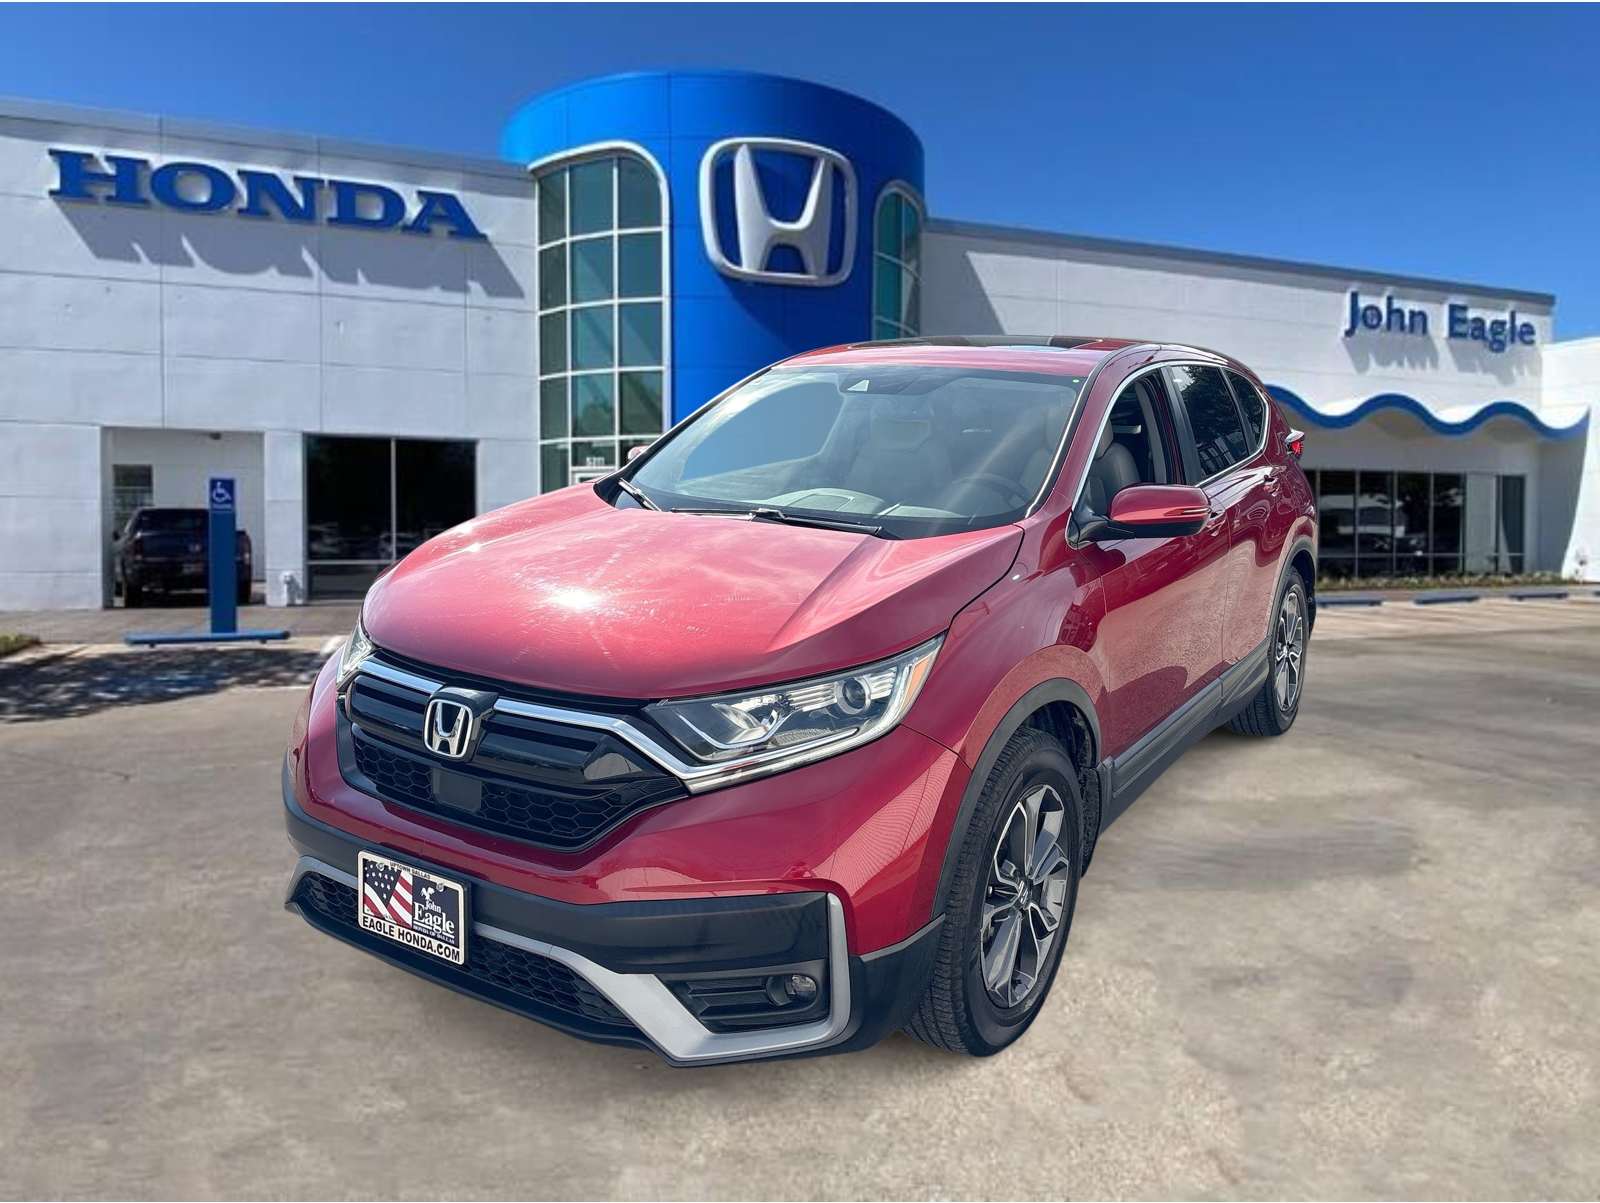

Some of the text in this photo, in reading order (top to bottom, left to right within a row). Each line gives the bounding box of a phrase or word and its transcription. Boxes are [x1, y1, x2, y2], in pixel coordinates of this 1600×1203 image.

[48, 148, 488, 240] HONDA
[1344, 291, 1536, 353] John Eagle
[389, 861, 431, 880] UPTOWN DALLAS
[413, 901, 455, 934] Eagle
[425, 900, 442, 914] John
[362, 916, 460, 963] EAGLE HONDA.COM
